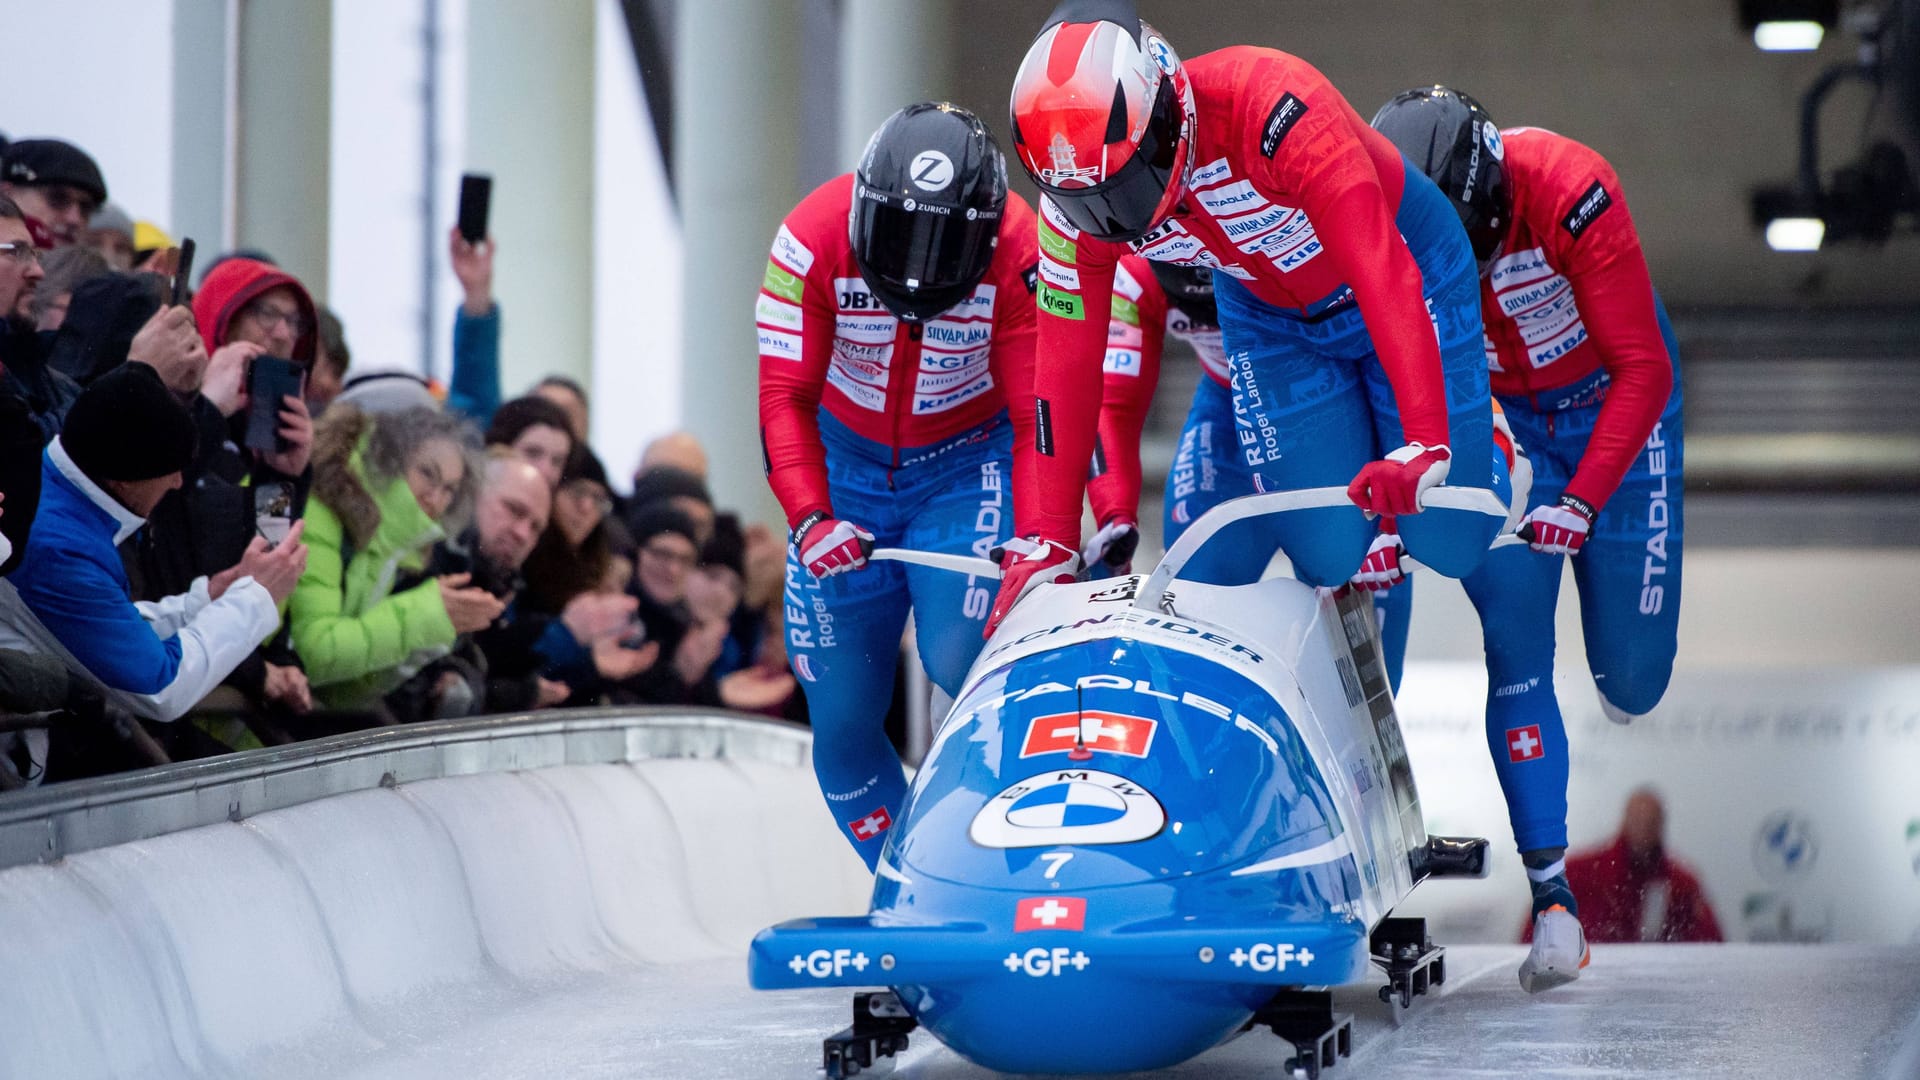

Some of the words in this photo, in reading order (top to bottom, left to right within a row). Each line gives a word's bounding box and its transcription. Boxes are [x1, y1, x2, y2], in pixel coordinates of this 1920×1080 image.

[1190, 164, 1228, 186] STADLER
[1463, 119, 1481, 203] STADLER
[865, 190, 888, 204] ZURICH
[917, 203, 951, 216] ZURICH
[1205, 190, 1257, 208] STADLER
[1224, 209, 1287, 237] SILVAPLANA
[1280, 240, 1321, 268] KIB
[1504, 278, 1565, 313] SILVAPLANA
[927, 326, 989, 344] SILVAPLANA
[1536, 328, 1587, 363] KIBA
[1225, 353, 1266, 467] RE/MAX
[1255, 412, 1283, 462] Roger
[794, 515, 818, 545] HIRZL
[1639, 421, 1669, 616] STADLER
[962, 460, 1002, 621] SADLER
[786, 541, 816, 649] RE/MA
[810, 594, 838, 648] Roger
[1000, 771, 1145, 799] BMW
[1041, 852, 1074, 880] 7
